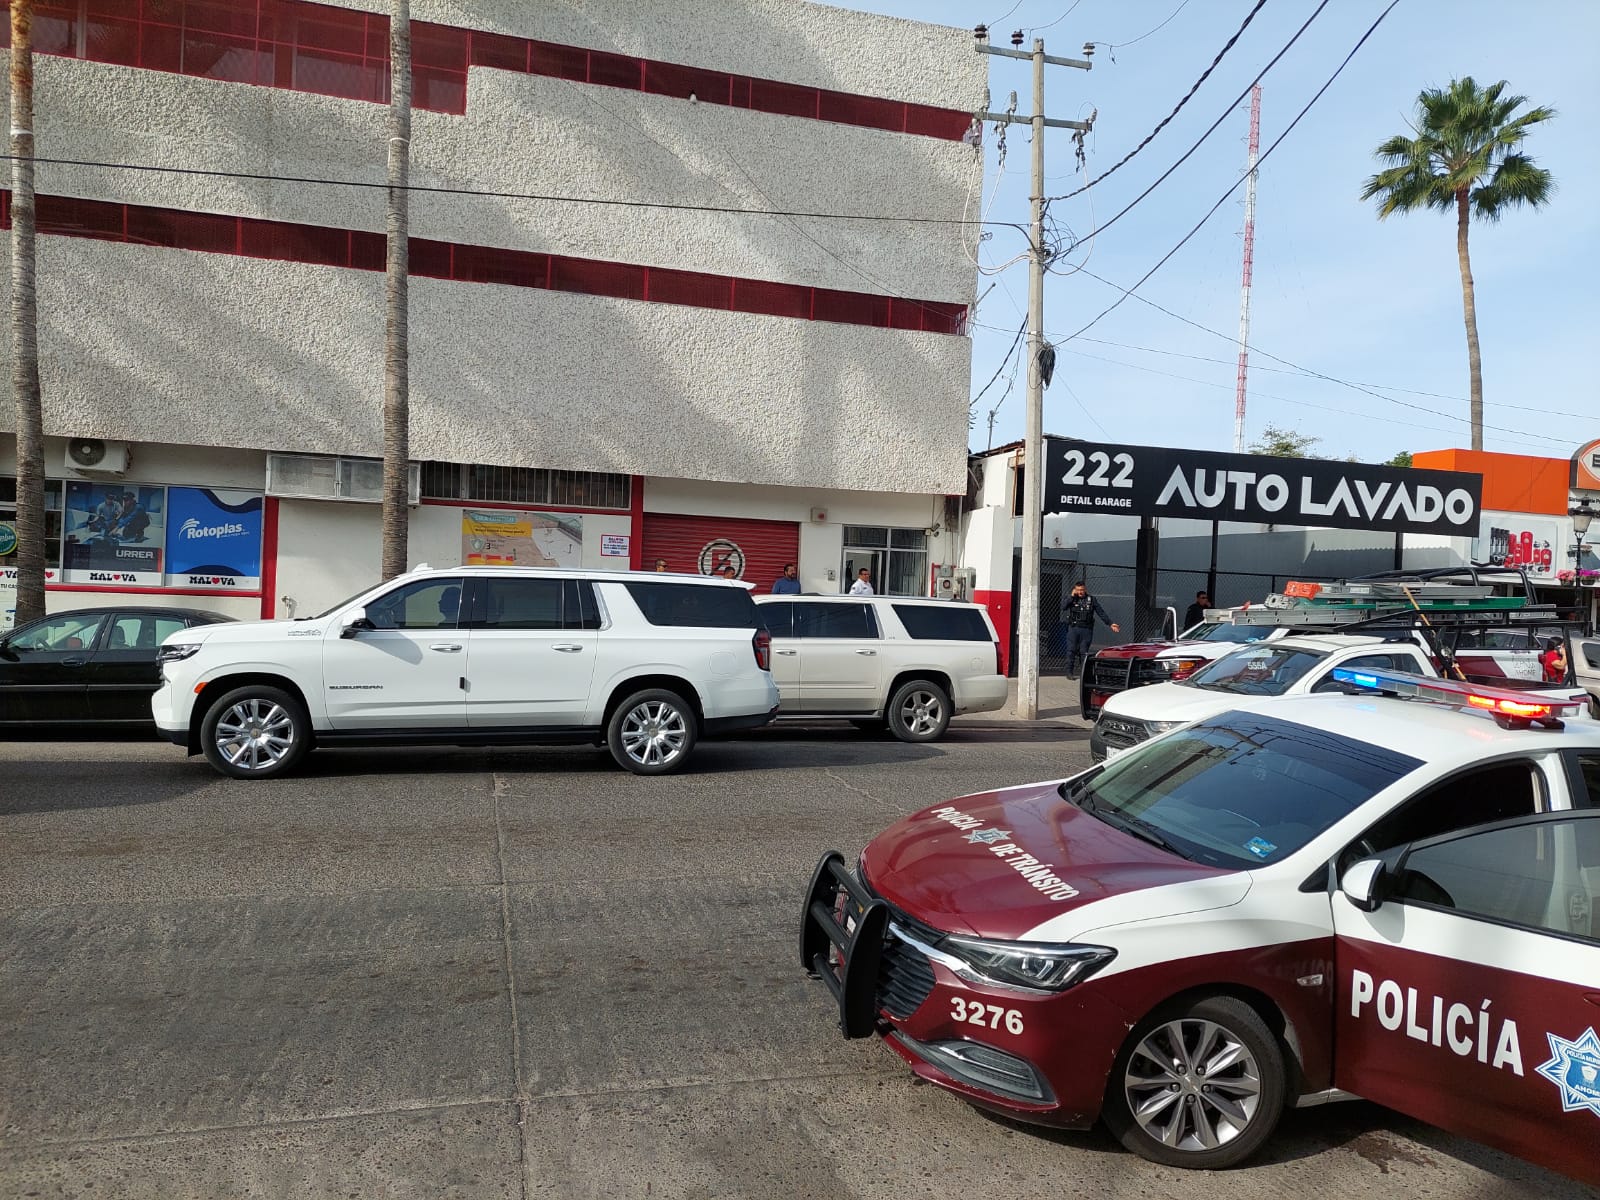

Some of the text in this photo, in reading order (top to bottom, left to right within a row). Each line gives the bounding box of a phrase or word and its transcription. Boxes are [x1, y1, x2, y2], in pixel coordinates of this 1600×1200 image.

[1062, 449, 1135, 489] 222
[1060, 495, 1132, 508] DETAIL GARAGE
[1154, 464, 1474, 525] AUTO LAVADO
[187, 523, 244, 539] Rotoplas
[115, 549, 154, 559] URREA
[930, 806, 1080, 901] POLICÍA DE TRÁNSITO
[950, 996, 1024, 1035] 3276
[1351, 969, 1525, 1077] POLICÍA
